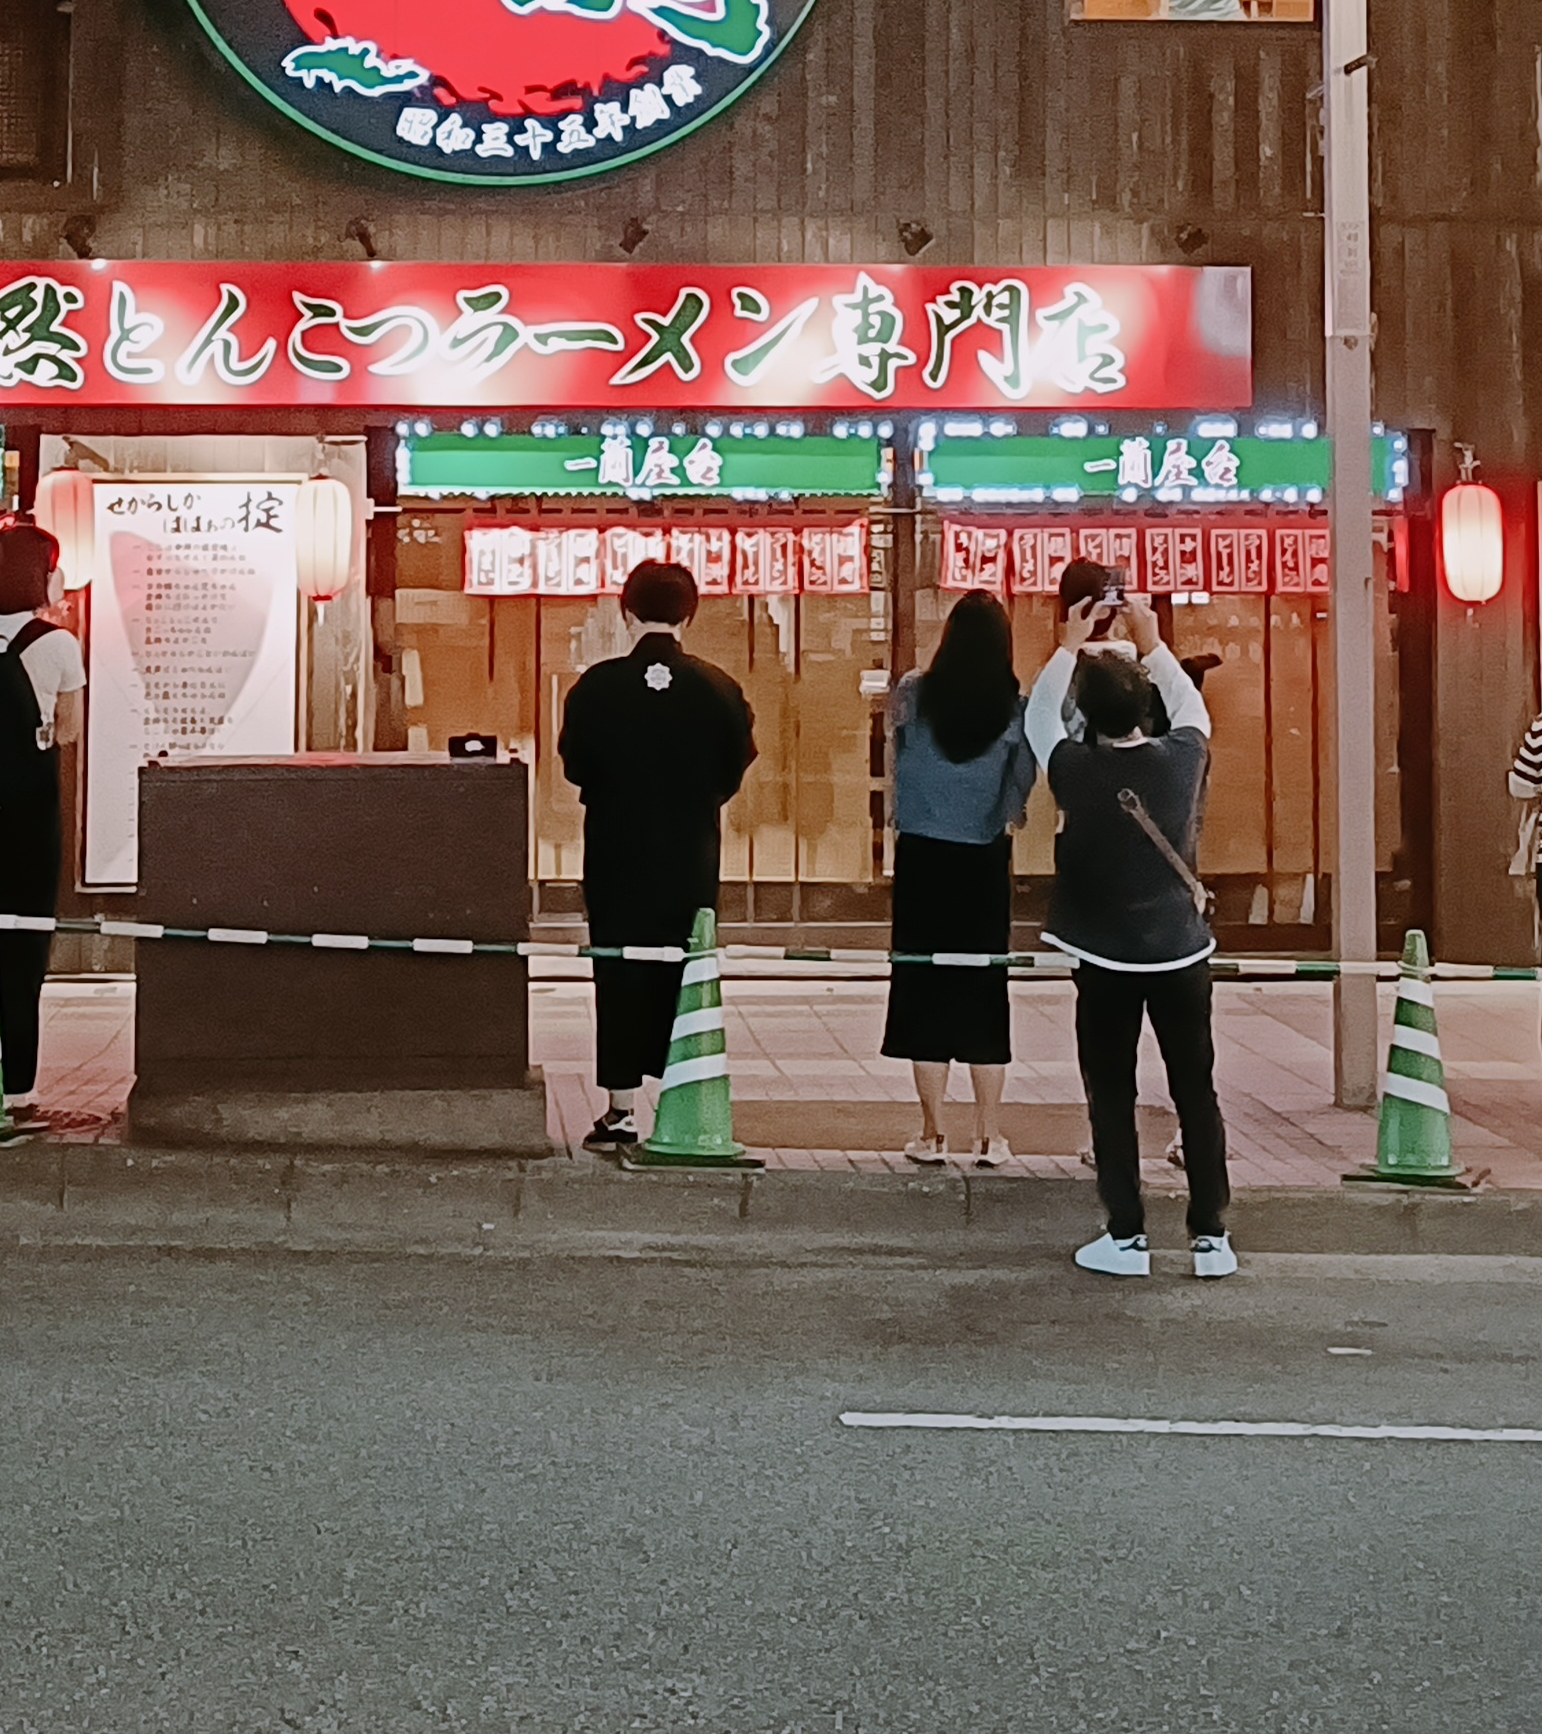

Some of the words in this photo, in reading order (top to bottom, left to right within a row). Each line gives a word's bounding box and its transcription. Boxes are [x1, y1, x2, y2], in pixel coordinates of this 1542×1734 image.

[564, 436, 723, 487] 一蘭屋台
[1083, 436, 1240, 488] 一蘭屋台
